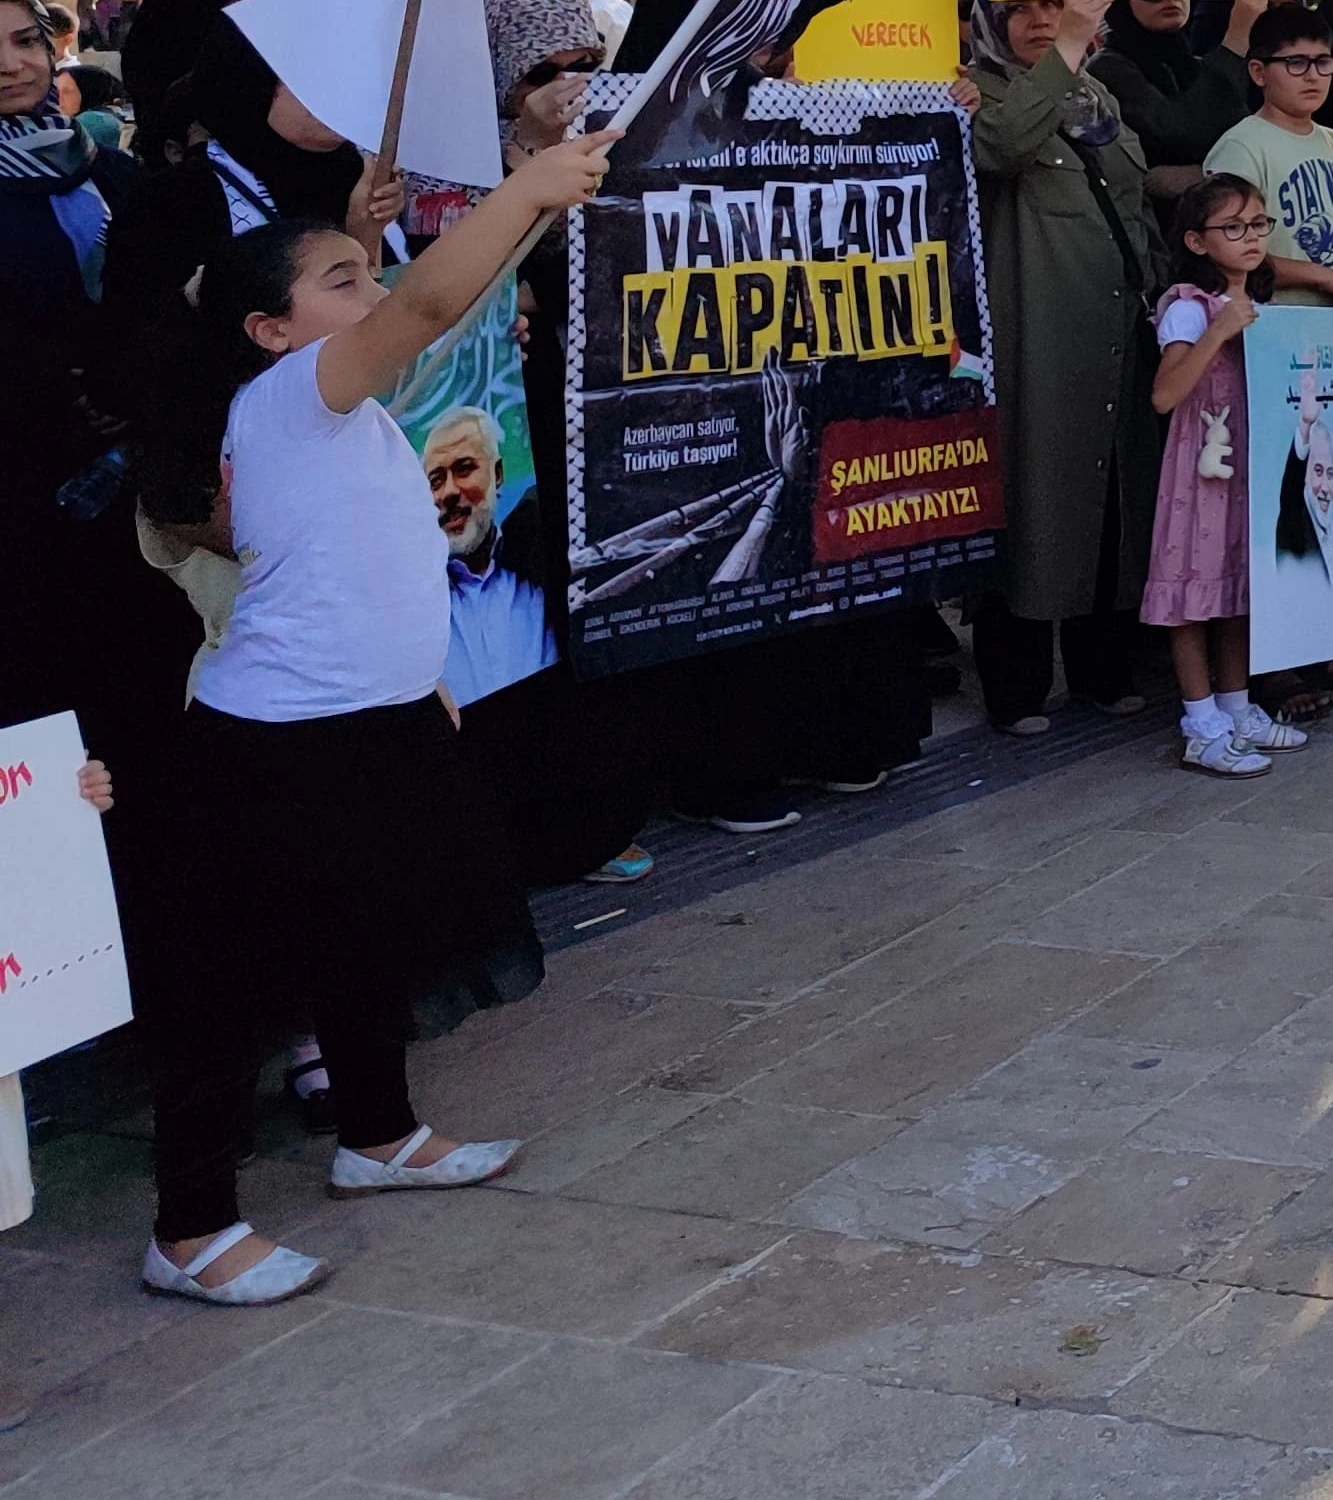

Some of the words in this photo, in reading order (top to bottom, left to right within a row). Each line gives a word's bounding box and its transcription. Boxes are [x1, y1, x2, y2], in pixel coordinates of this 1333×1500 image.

[850, 20, 934, 51] VERECEK
[750, 138, 810, 170] aktıkça
[813, 139, 873, 171] soykırım
[875, 137, 942, 168] sürüyor!
[651, 183, 923, 274] VANALARI
[626, 252, 949, 374] KAPATIN!
[623, 421, 695, 448] Azerbaycan
[623, 447, 680, 473] Türkiye
[682, 438, 738, 467] taşıyor!
[845, 485, 981, 536] AYAKTAYIZ!
